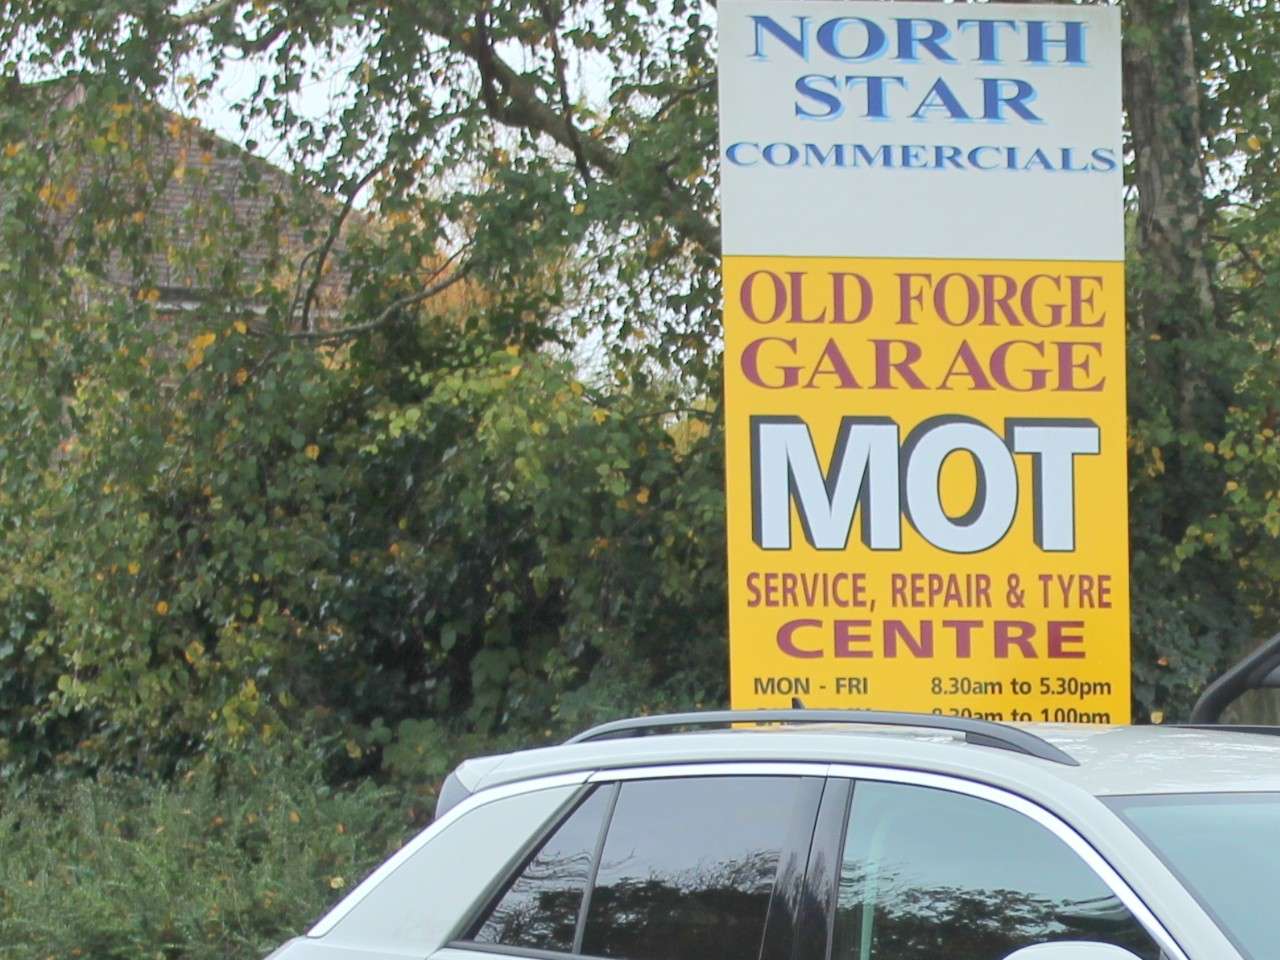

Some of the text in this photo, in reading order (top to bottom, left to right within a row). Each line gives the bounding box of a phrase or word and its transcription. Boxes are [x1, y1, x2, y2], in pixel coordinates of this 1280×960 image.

[746, 15, 1090, 66] NORTH
[794, 74, 1047, 125] STAR
[725, 141, 1118, 173] COMMERCIALS
[739, 269, 1106, 328] OLD FORGE
[740, 336, 1106, 392] GARAGE
[749, 413, 1101, 554] MOT
[746, 572, 1112, 612] SERVICE, REPAIR & TYRE
[775, 618, 1086, 659] CENTRE
[754, 677, 810, 695] MON
[835, 677, 869, 695] FRI
[931, 677, 1111, 700] 8.30am to 5.30pm
[1010, 709, 1032, 722] to
